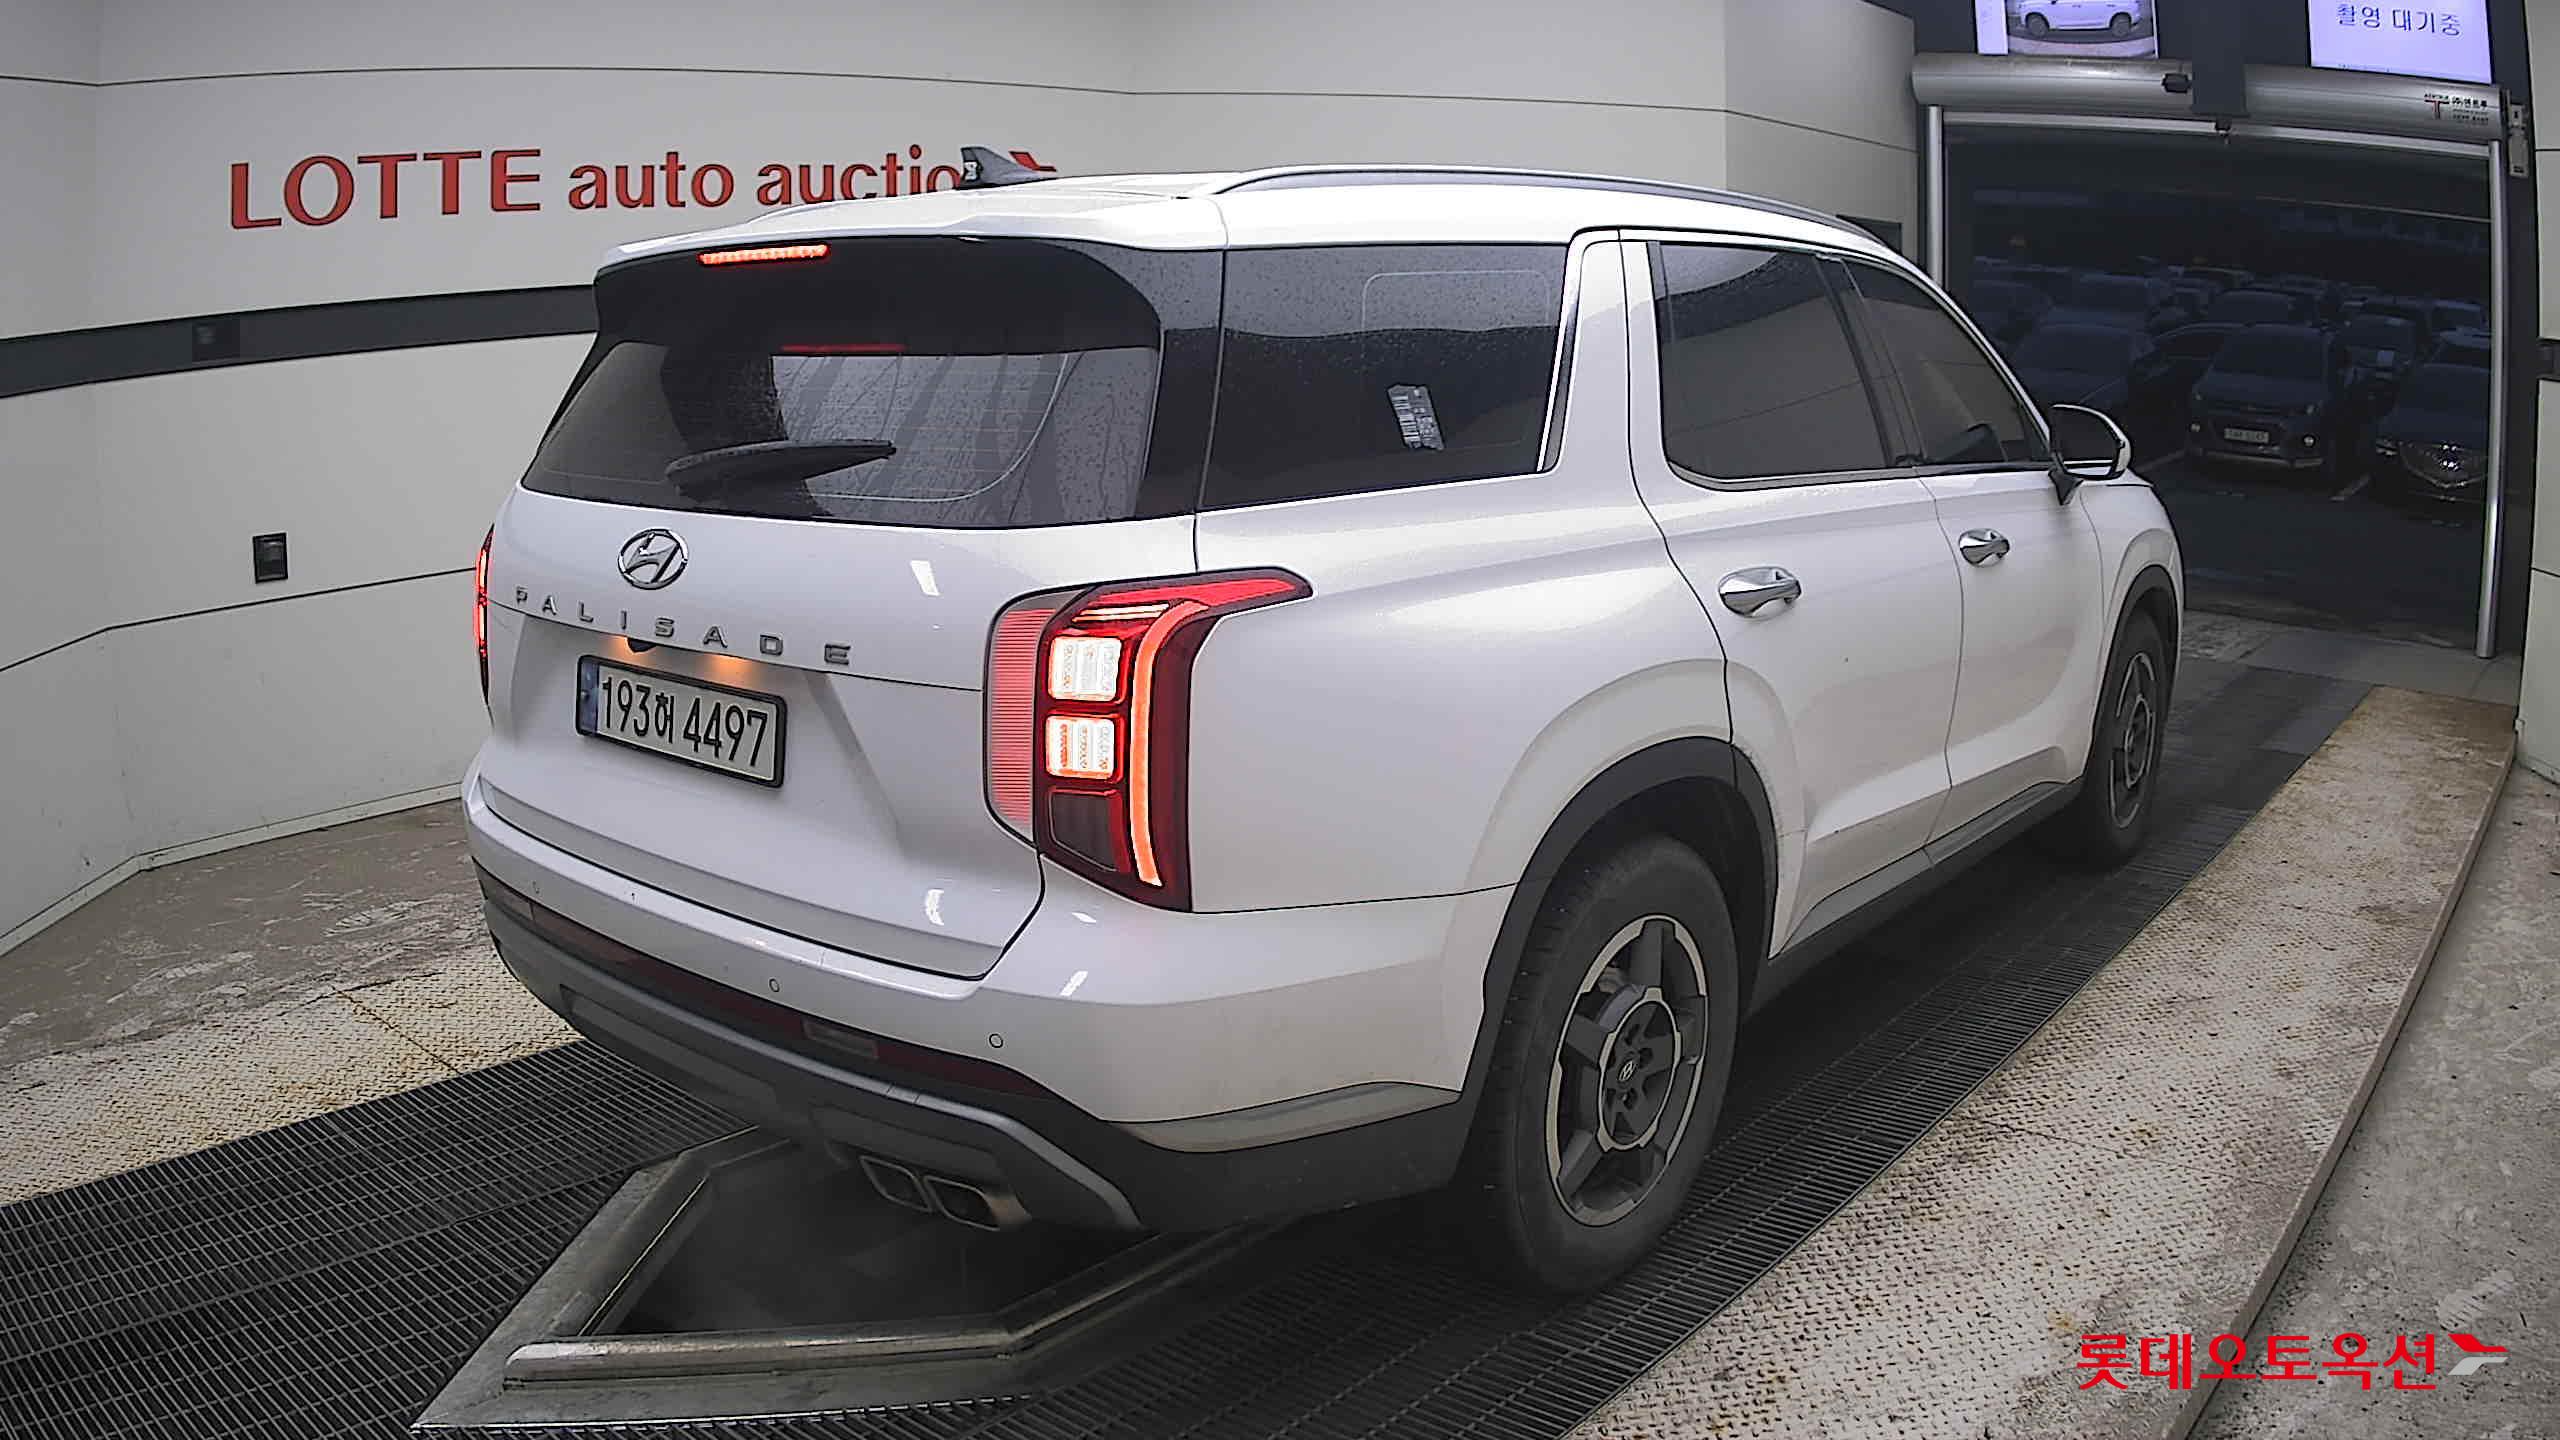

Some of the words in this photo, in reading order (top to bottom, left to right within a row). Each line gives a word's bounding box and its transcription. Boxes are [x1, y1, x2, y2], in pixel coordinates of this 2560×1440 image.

[2337, 4, 2380, 29] 촬영
[2391, 9, 2461, 36] 대기중
[231, 148, 541, 230] LOTTE
[568, 149, 735, 209] auto
[756, 144, 961, 206] auctio
[514, 585, 852, 666] PALISADE
[602, 677, 675, 744] 193허
[684, 697, 768, 768] 4497
